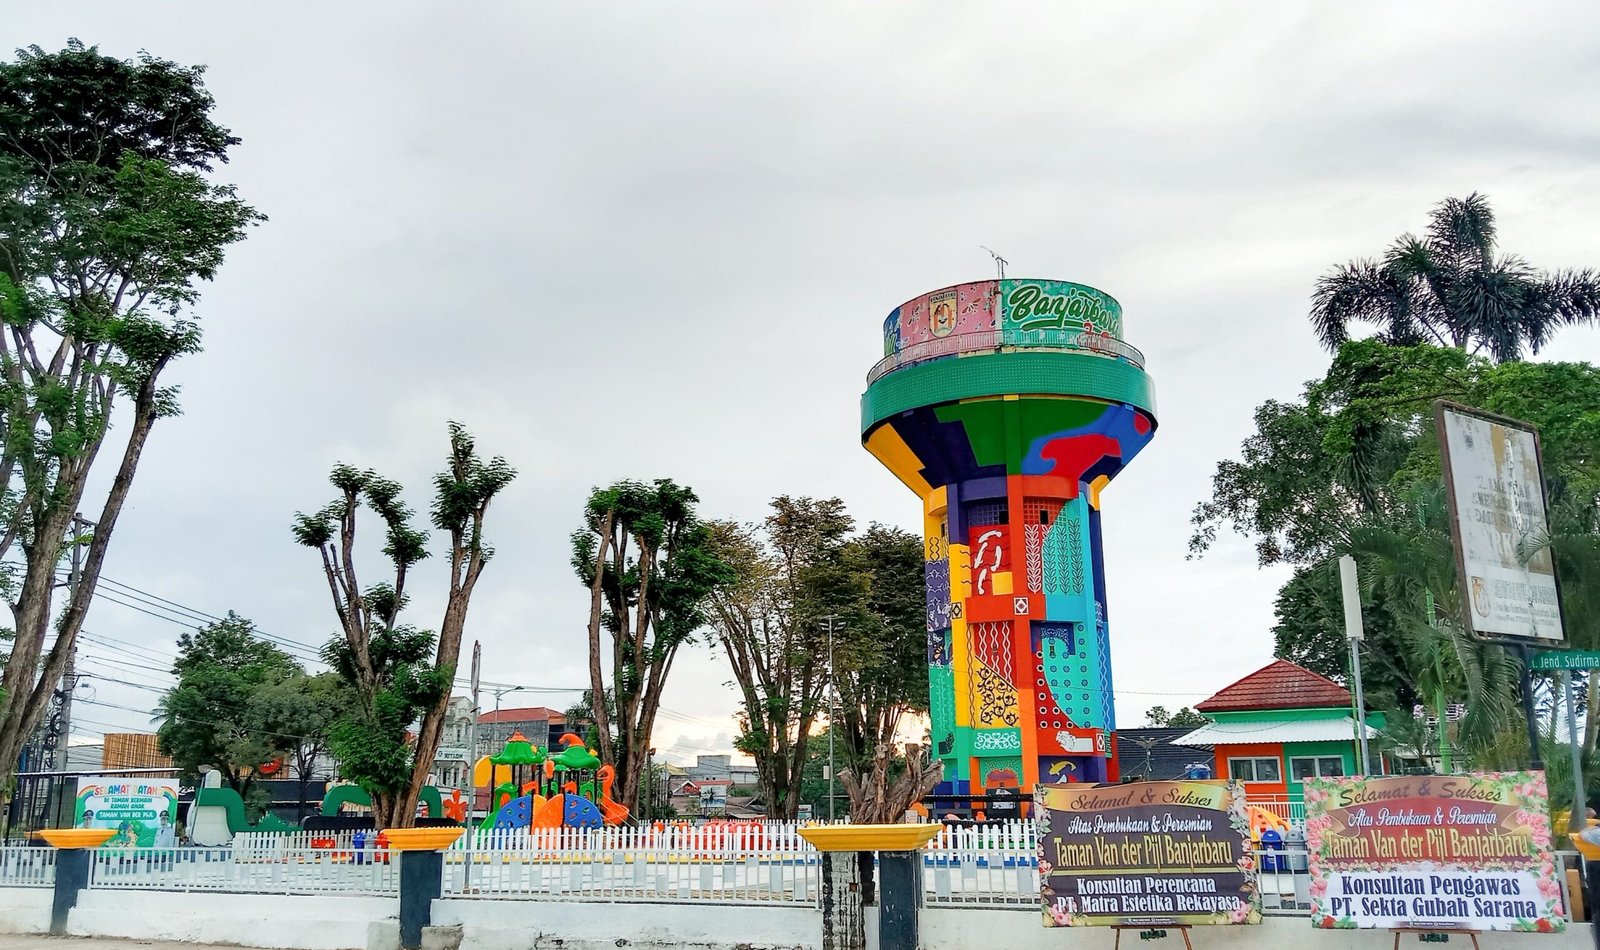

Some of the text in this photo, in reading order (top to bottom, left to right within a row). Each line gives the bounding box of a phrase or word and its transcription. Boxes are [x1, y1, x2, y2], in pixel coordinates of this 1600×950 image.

[1008, 284, 1120, 335] Banjarbaru
[1540, 655, 1562, 668] Jend.
[1564, 654, 1600, 668] Sudirma
[1070, 787, 1213, 810] Selamat & Sukses
[1339, 779, 1502, 807] Selamat & Sukses
[1068, 812, 1213, 834] Atas Pembukaan & Peresmian
[1348, 806, 1498, 827] Atas Pembukaan & Peresmian
[1054, 834, 1233, 873] Taman Van der Pijl Banjarbaru
[1325, 828, 1530, 866] Taman Van der Pijl Banjarbaru
[1076, 877, 1216, 895] Konsultan Perencana
[1342, 876, 1520, 897] Konsultan Pengawas
[1056, 894, 1241, 913] PT. Matra Estetika Rekayasa
[1331, 897, 1538, 918] PT. Sekta Gubah Sarana
